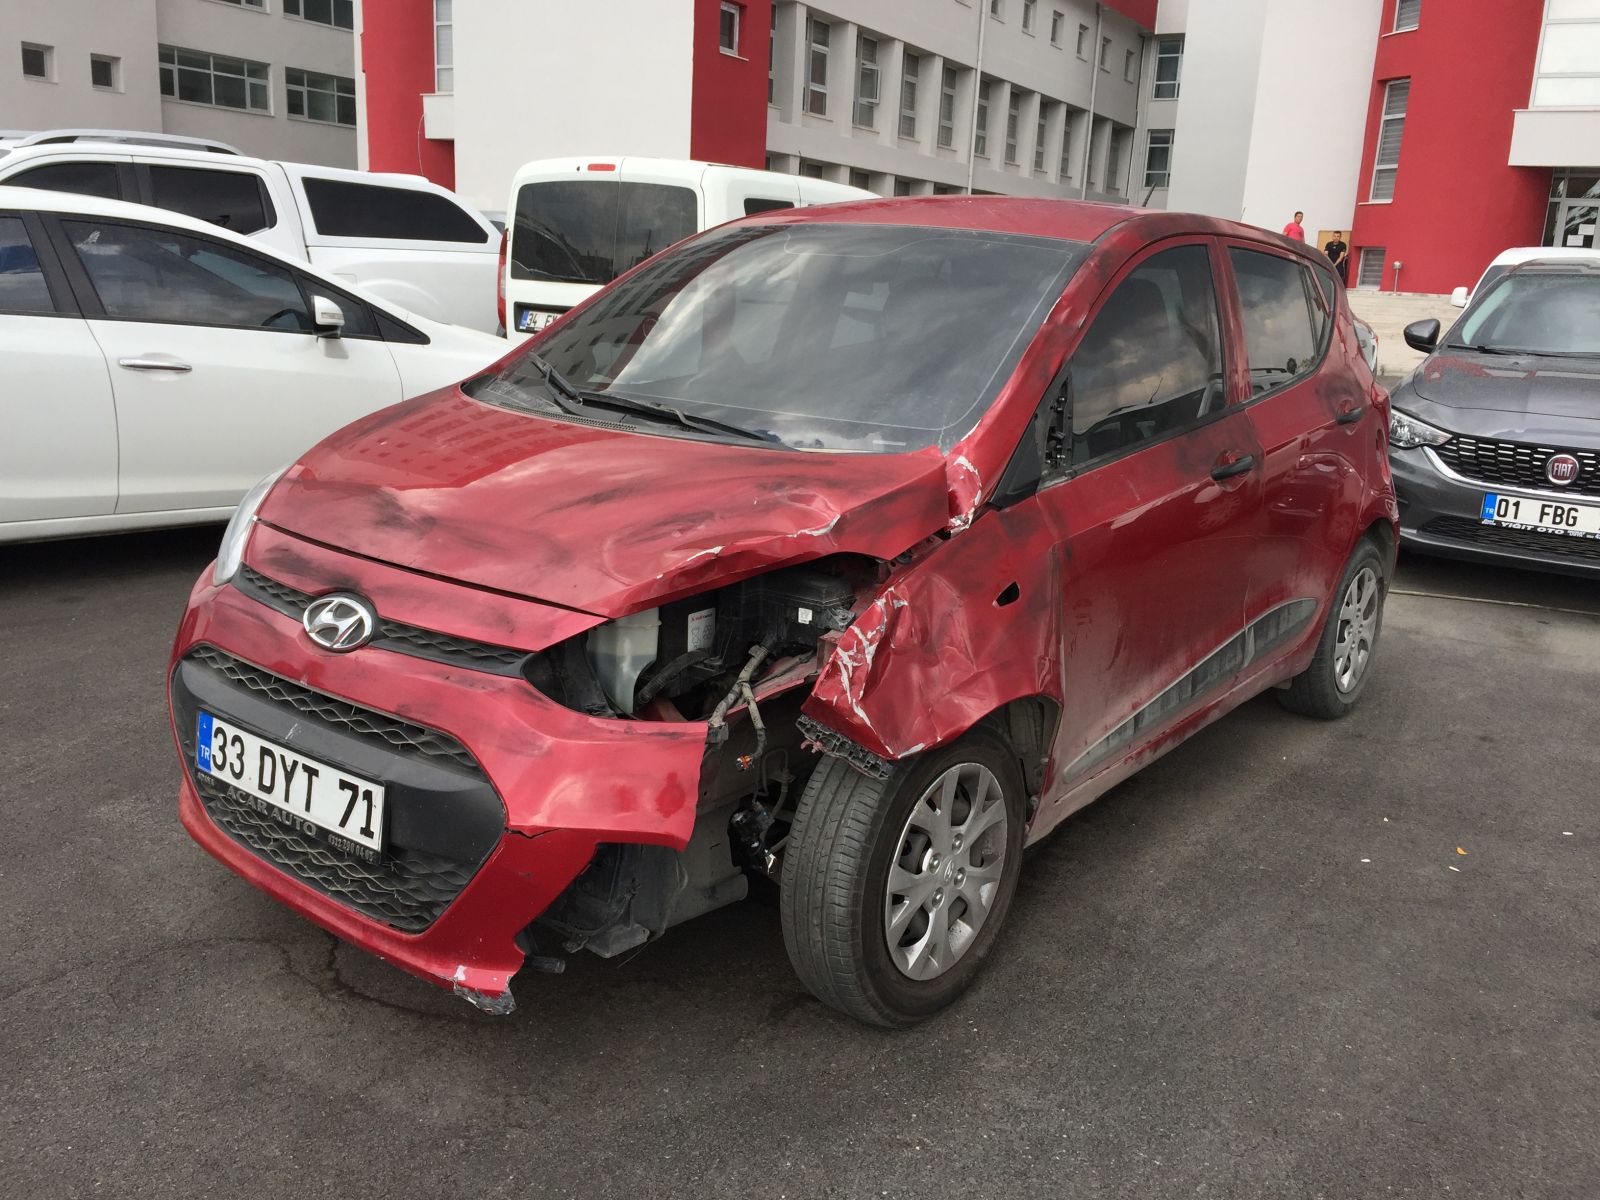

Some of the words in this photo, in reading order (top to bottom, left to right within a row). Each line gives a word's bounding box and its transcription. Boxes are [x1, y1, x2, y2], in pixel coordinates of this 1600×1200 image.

[527, 312, 537, 327] 34
[1553, 462, 1573, 477] FIAT
[1496, 498, 1521, 520] 01
[1538, 503, 1579, 527] FBG
[1536, 527, 1565, 535] OTO
[200, 744, 210, 761] TR
[211, 726, 245, 780] 33
[258, 746, 319, 812] DYT
[338, 778, 374, 839] 71
[226, 785, 269, 816] ACAR
[270, 807, 317, 836] AUTO
